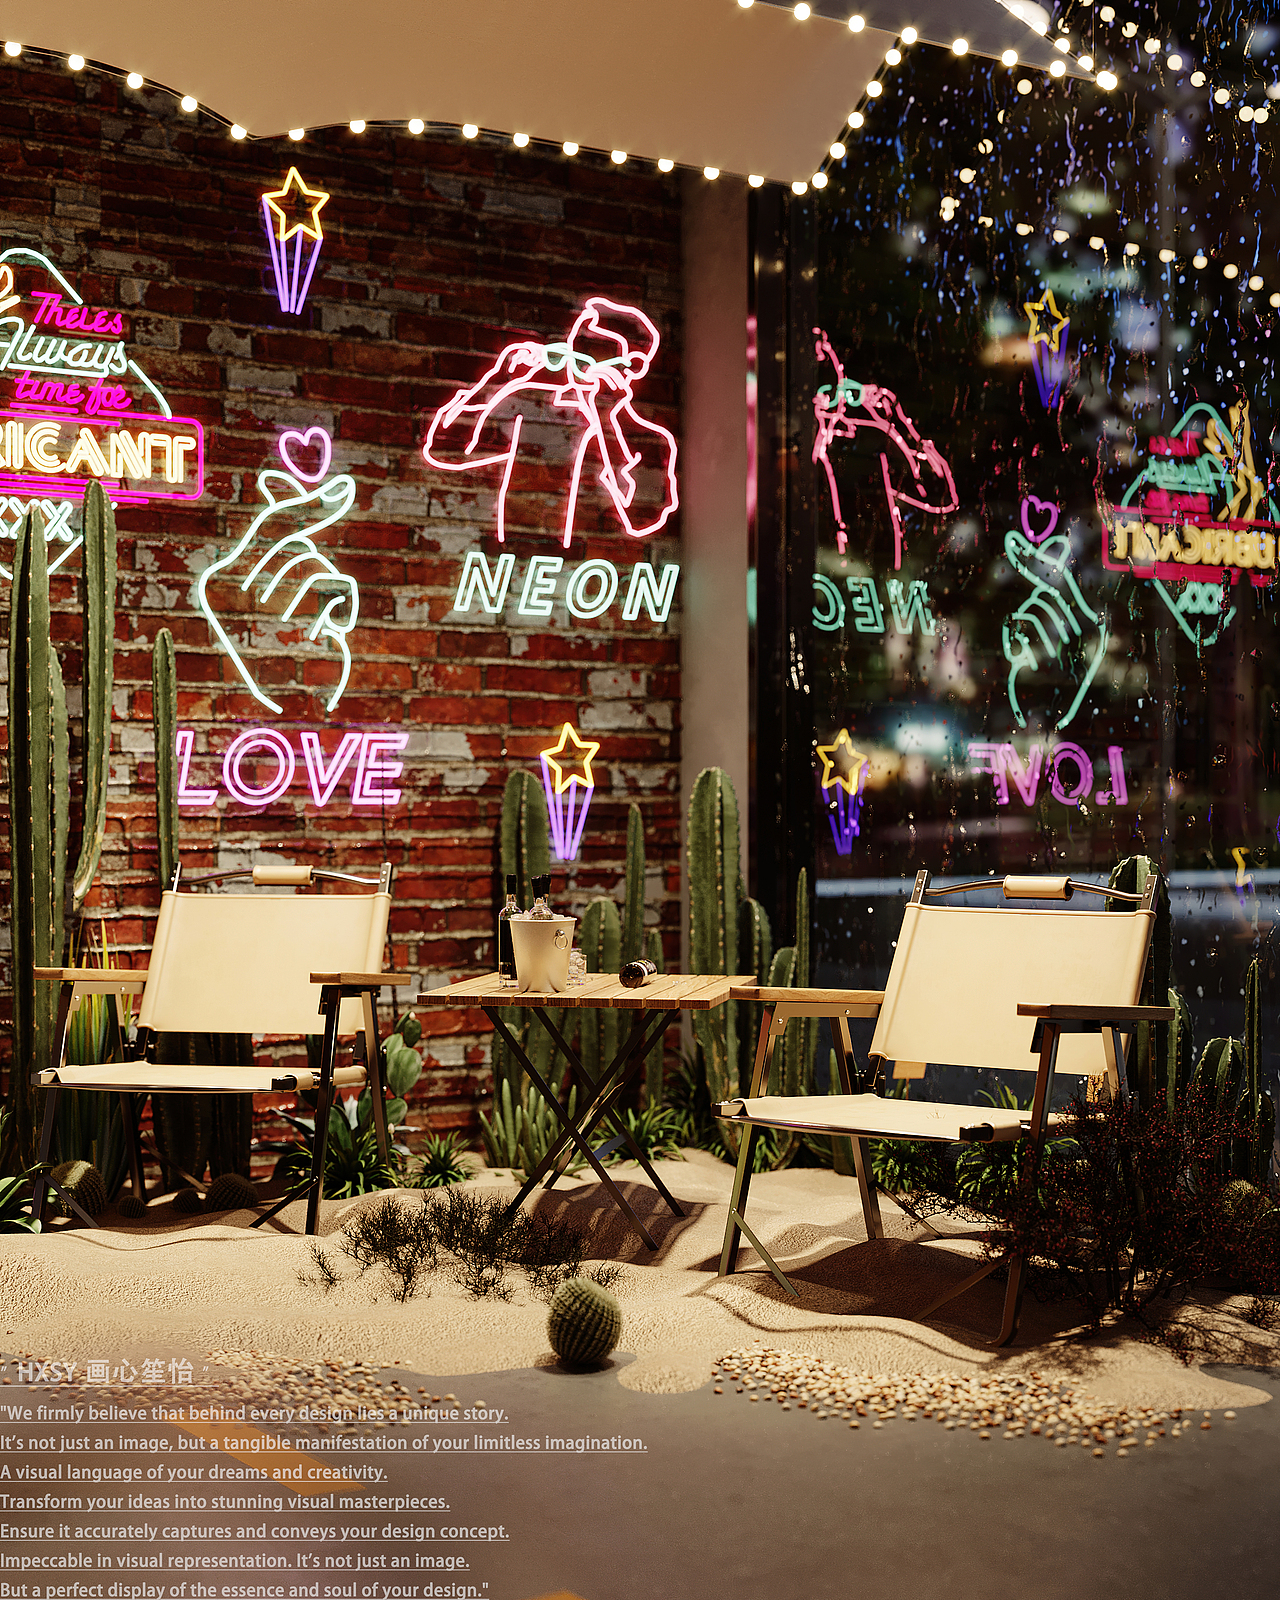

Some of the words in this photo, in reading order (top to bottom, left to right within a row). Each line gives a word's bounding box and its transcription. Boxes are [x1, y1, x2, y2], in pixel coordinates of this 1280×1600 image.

[0, 420, 196, 484] ICANT
[453, 551, 680, 623] NEON
[176, 727, 410, 807] LOVE
